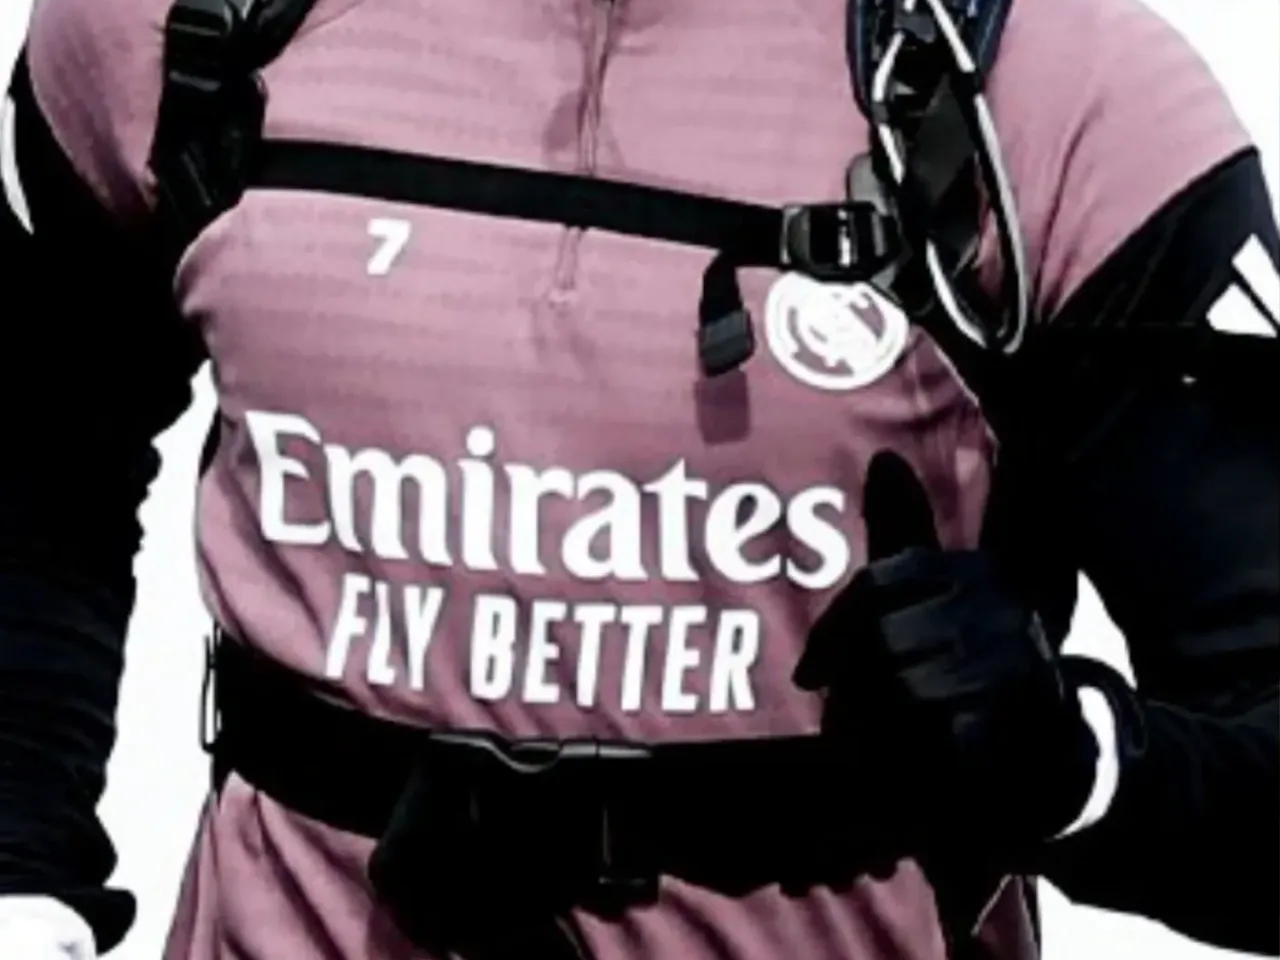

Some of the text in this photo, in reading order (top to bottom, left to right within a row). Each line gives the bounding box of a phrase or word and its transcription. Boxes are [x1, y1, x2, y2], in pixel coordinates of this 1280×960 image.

[365, 214, 414, 277] 7
[244, 409, 852, 590] Emirates
[324, 572, 760, 713] FLY BETTER
